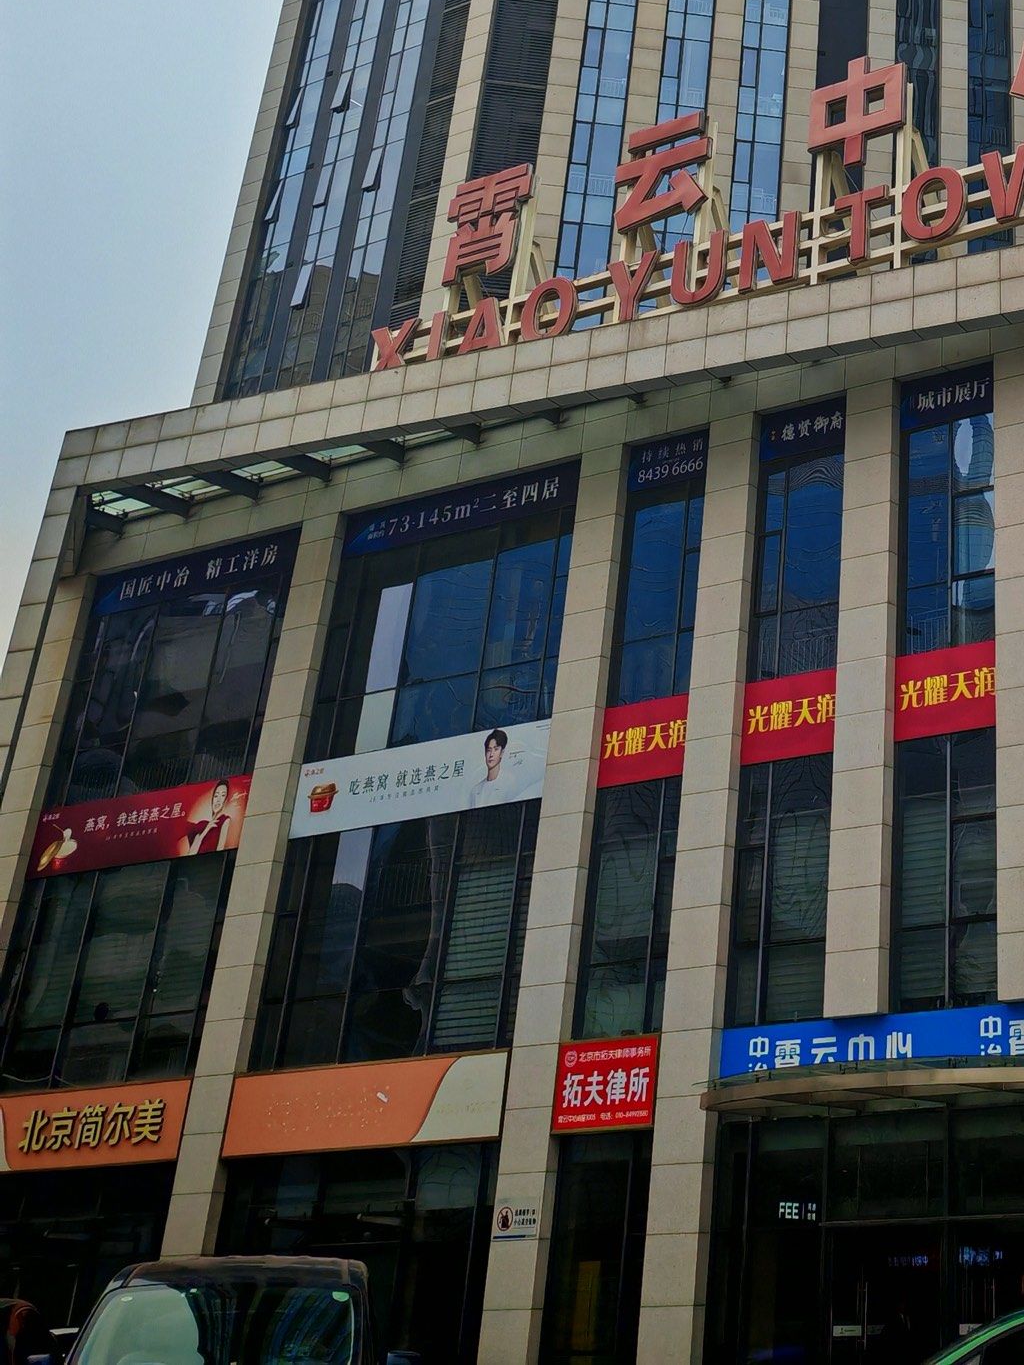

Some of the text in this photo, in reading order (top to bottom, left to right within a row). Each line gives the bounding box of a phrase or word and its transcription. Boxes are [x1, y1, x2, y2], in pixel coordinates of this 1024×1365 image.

[371, 211, 799, 370] XIAOYUN
[917, 377, 990, 412] 城市展厅
[781, 411, 844, 441] 德贤御府
[638, 464, 669, 483] 8439
[672, 456, 703, 475] 6666
[119, 544, 279, 601] 国匠中冶 精工洋房
[349, 773, 390, 796] 吃燕窝
[396, 759, 465, 788] 就选燕之屋
[562, 1067, 650, 1108] 拓夫律所
[18, 1099, 164, 1153] 北京简尔美
